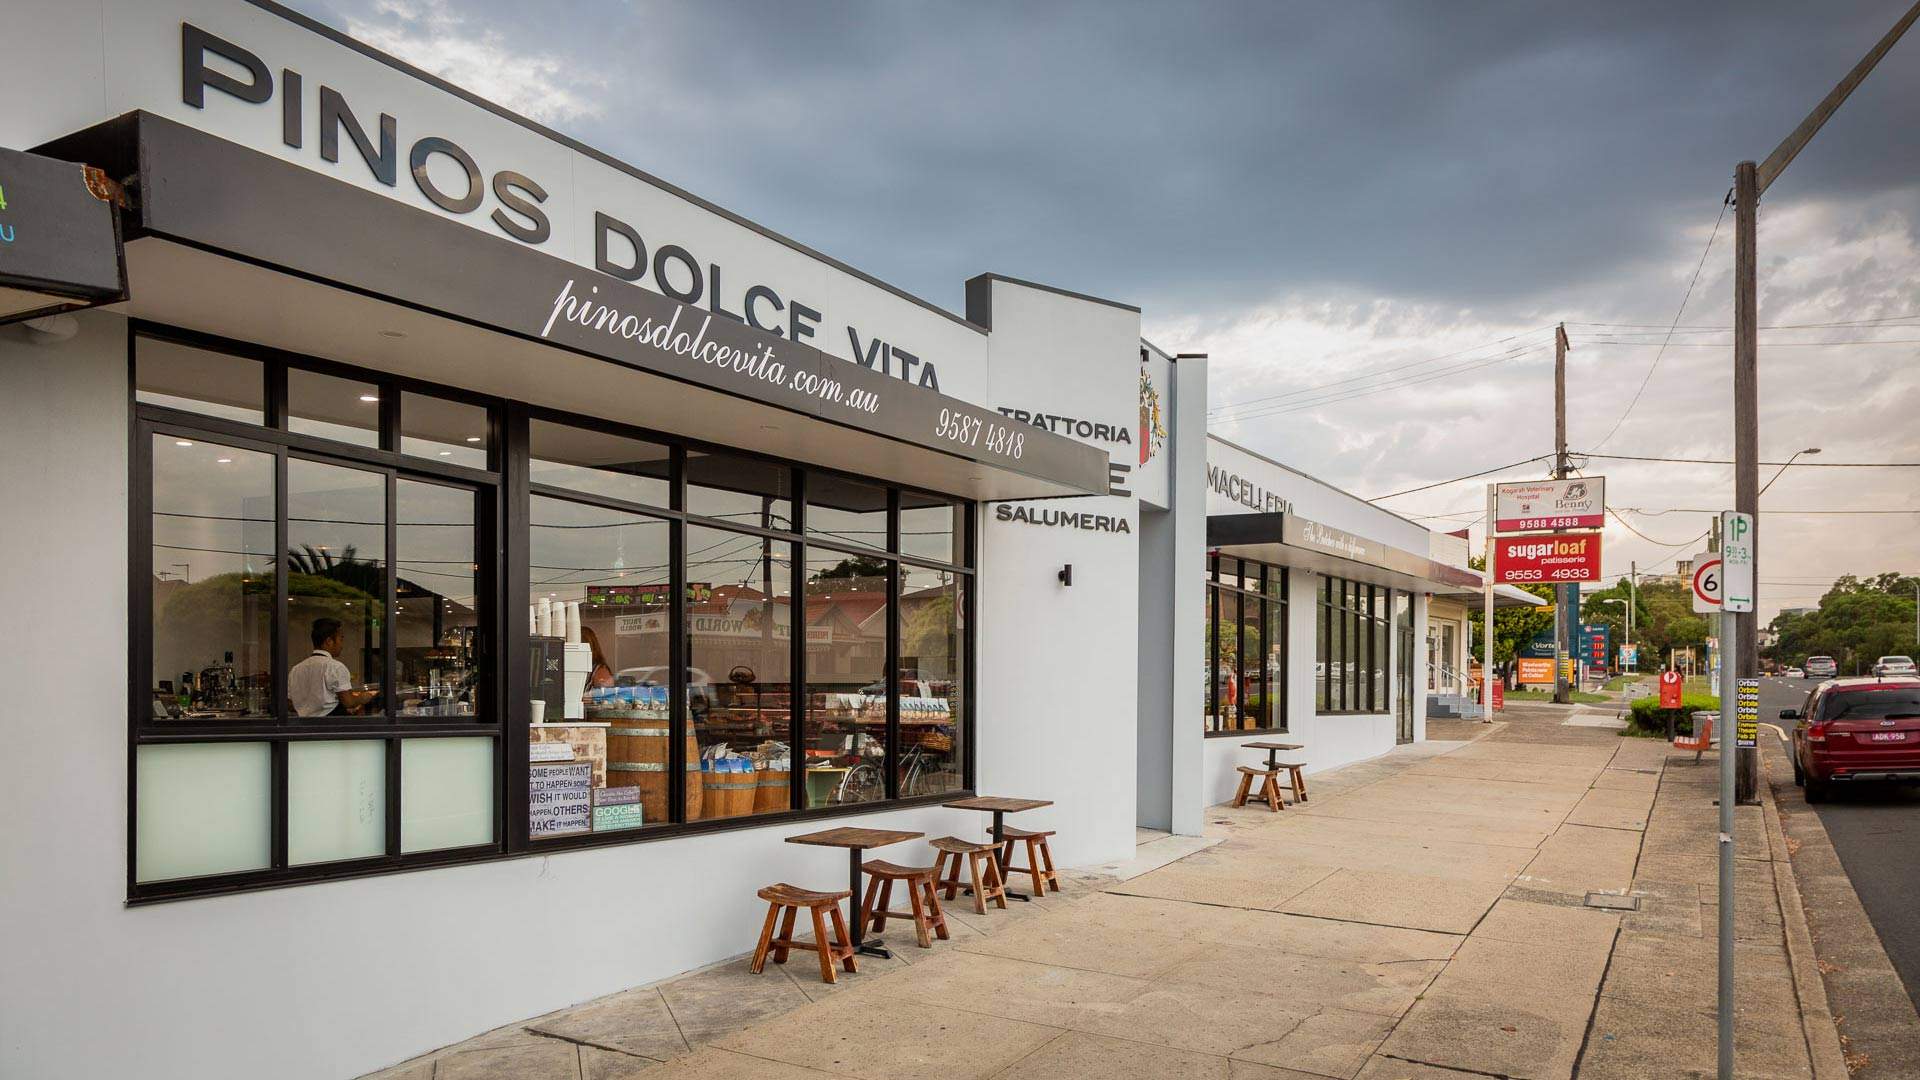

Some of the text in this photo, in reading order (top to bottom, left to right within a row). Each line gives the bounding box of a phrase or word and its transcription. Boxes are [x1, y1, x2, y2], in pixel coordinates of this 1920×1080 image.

[181, 22, 940, 393] PINOS DOLCE VITA
[541, 279, 1025, 459] pinosdolcevita.com.au 9587 4818
[997, 406, 1132, 444] TRATTORIA
[1555, 499, 1592, 512] Benny
[996, 503, 1131, 534] SALUMERIA
[1520, 517, 1579, 529] 9588 4588
[1729, 515, 1748, 542] 1P
[1507, 539, 1587, 560] sugarloaf
[1541, 555, 1586, 565] patisserie
[1505, 568, 1590, 580] 9553 4933
[1703, 573, 1718, 592] 6
[549, 768, 568, 776] PEOPLE
[569, 766, 589, 776] WANT
[536, 781, 544, 789] TO
[546, 780, 572, 789] HAPPEN
[530, 791, 587, 804] WISH IT WOULD
[553, 804, 588, 817] OTHERS
